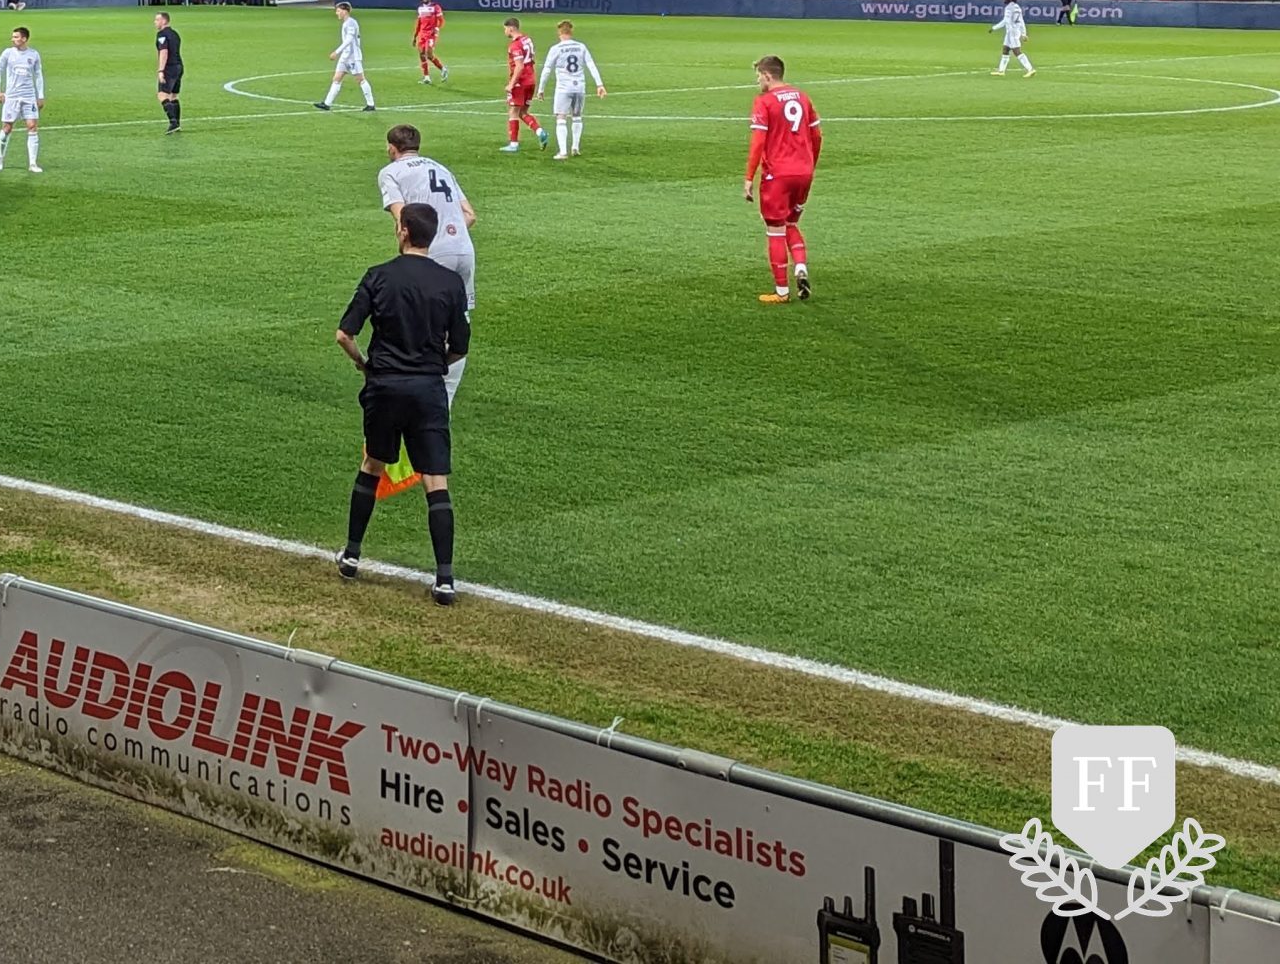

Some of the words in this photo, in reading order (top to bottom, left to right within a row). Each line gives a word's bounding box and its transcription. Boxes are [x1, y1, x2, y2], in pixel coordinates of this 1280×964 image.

[566, 55, 578, 73] 8
[784, 100, 803, 132] 9
[429, 169, 453, 202] 4
[0, 630, 366, 795] AUDIOLINK
[0, 694, 69, 736] radio
[87, 726, 352, 826] communications
[380, 768, 445, 814] Hire
[485, 796, 567, 853] Sales
[601, 837, 737, 910] Service
[381, 724, 517, 791] Two-Way
[527, 765, 612, 819] Radio
[622, 796, 808, 877] Specialists
[380, 826, 573, 906] audiolink.co.uk
